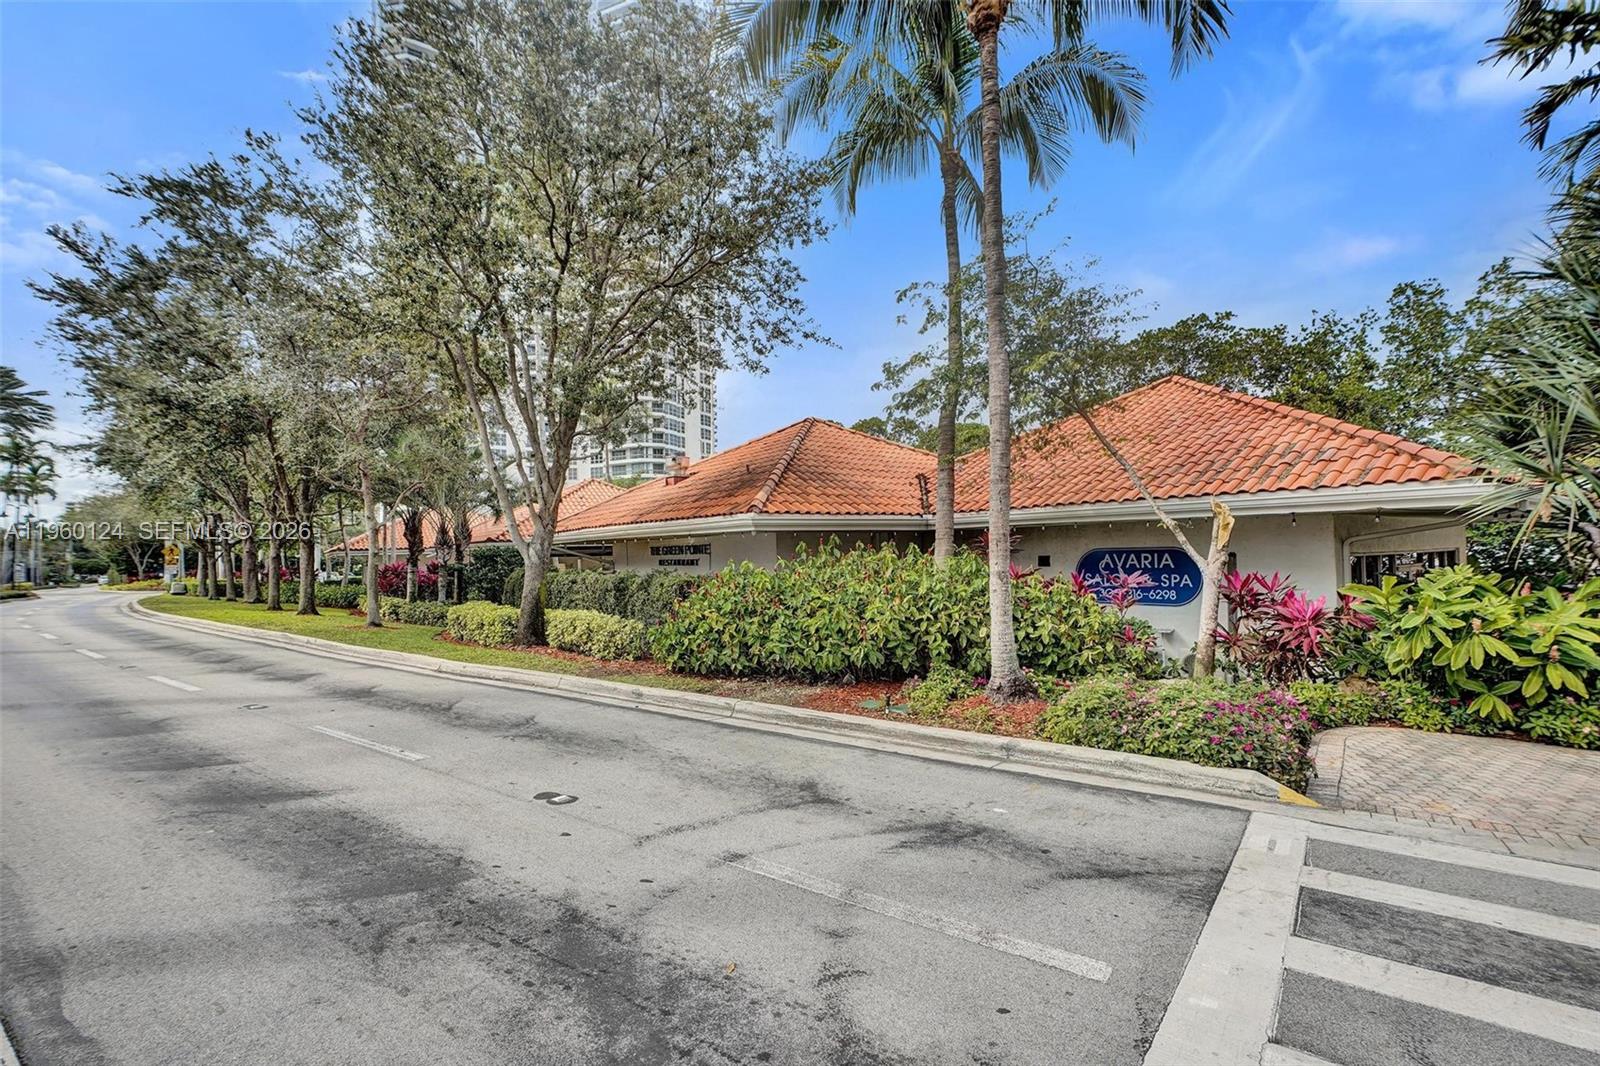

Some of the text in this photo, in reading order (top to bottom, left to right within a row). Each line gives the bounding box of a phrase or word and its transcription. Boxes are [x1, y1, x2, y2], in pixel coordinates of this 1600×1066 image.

[662, 545, 684, 556] GREEN
[685, 543, 711, 555] POINTE
[659, 558, 700, 567] RESTAURANT
[1099, 553, 1175, 570] AVARIA
[1085, 573, 1127, 587] SALO
[1160, 573, 1193, 588] SPA
